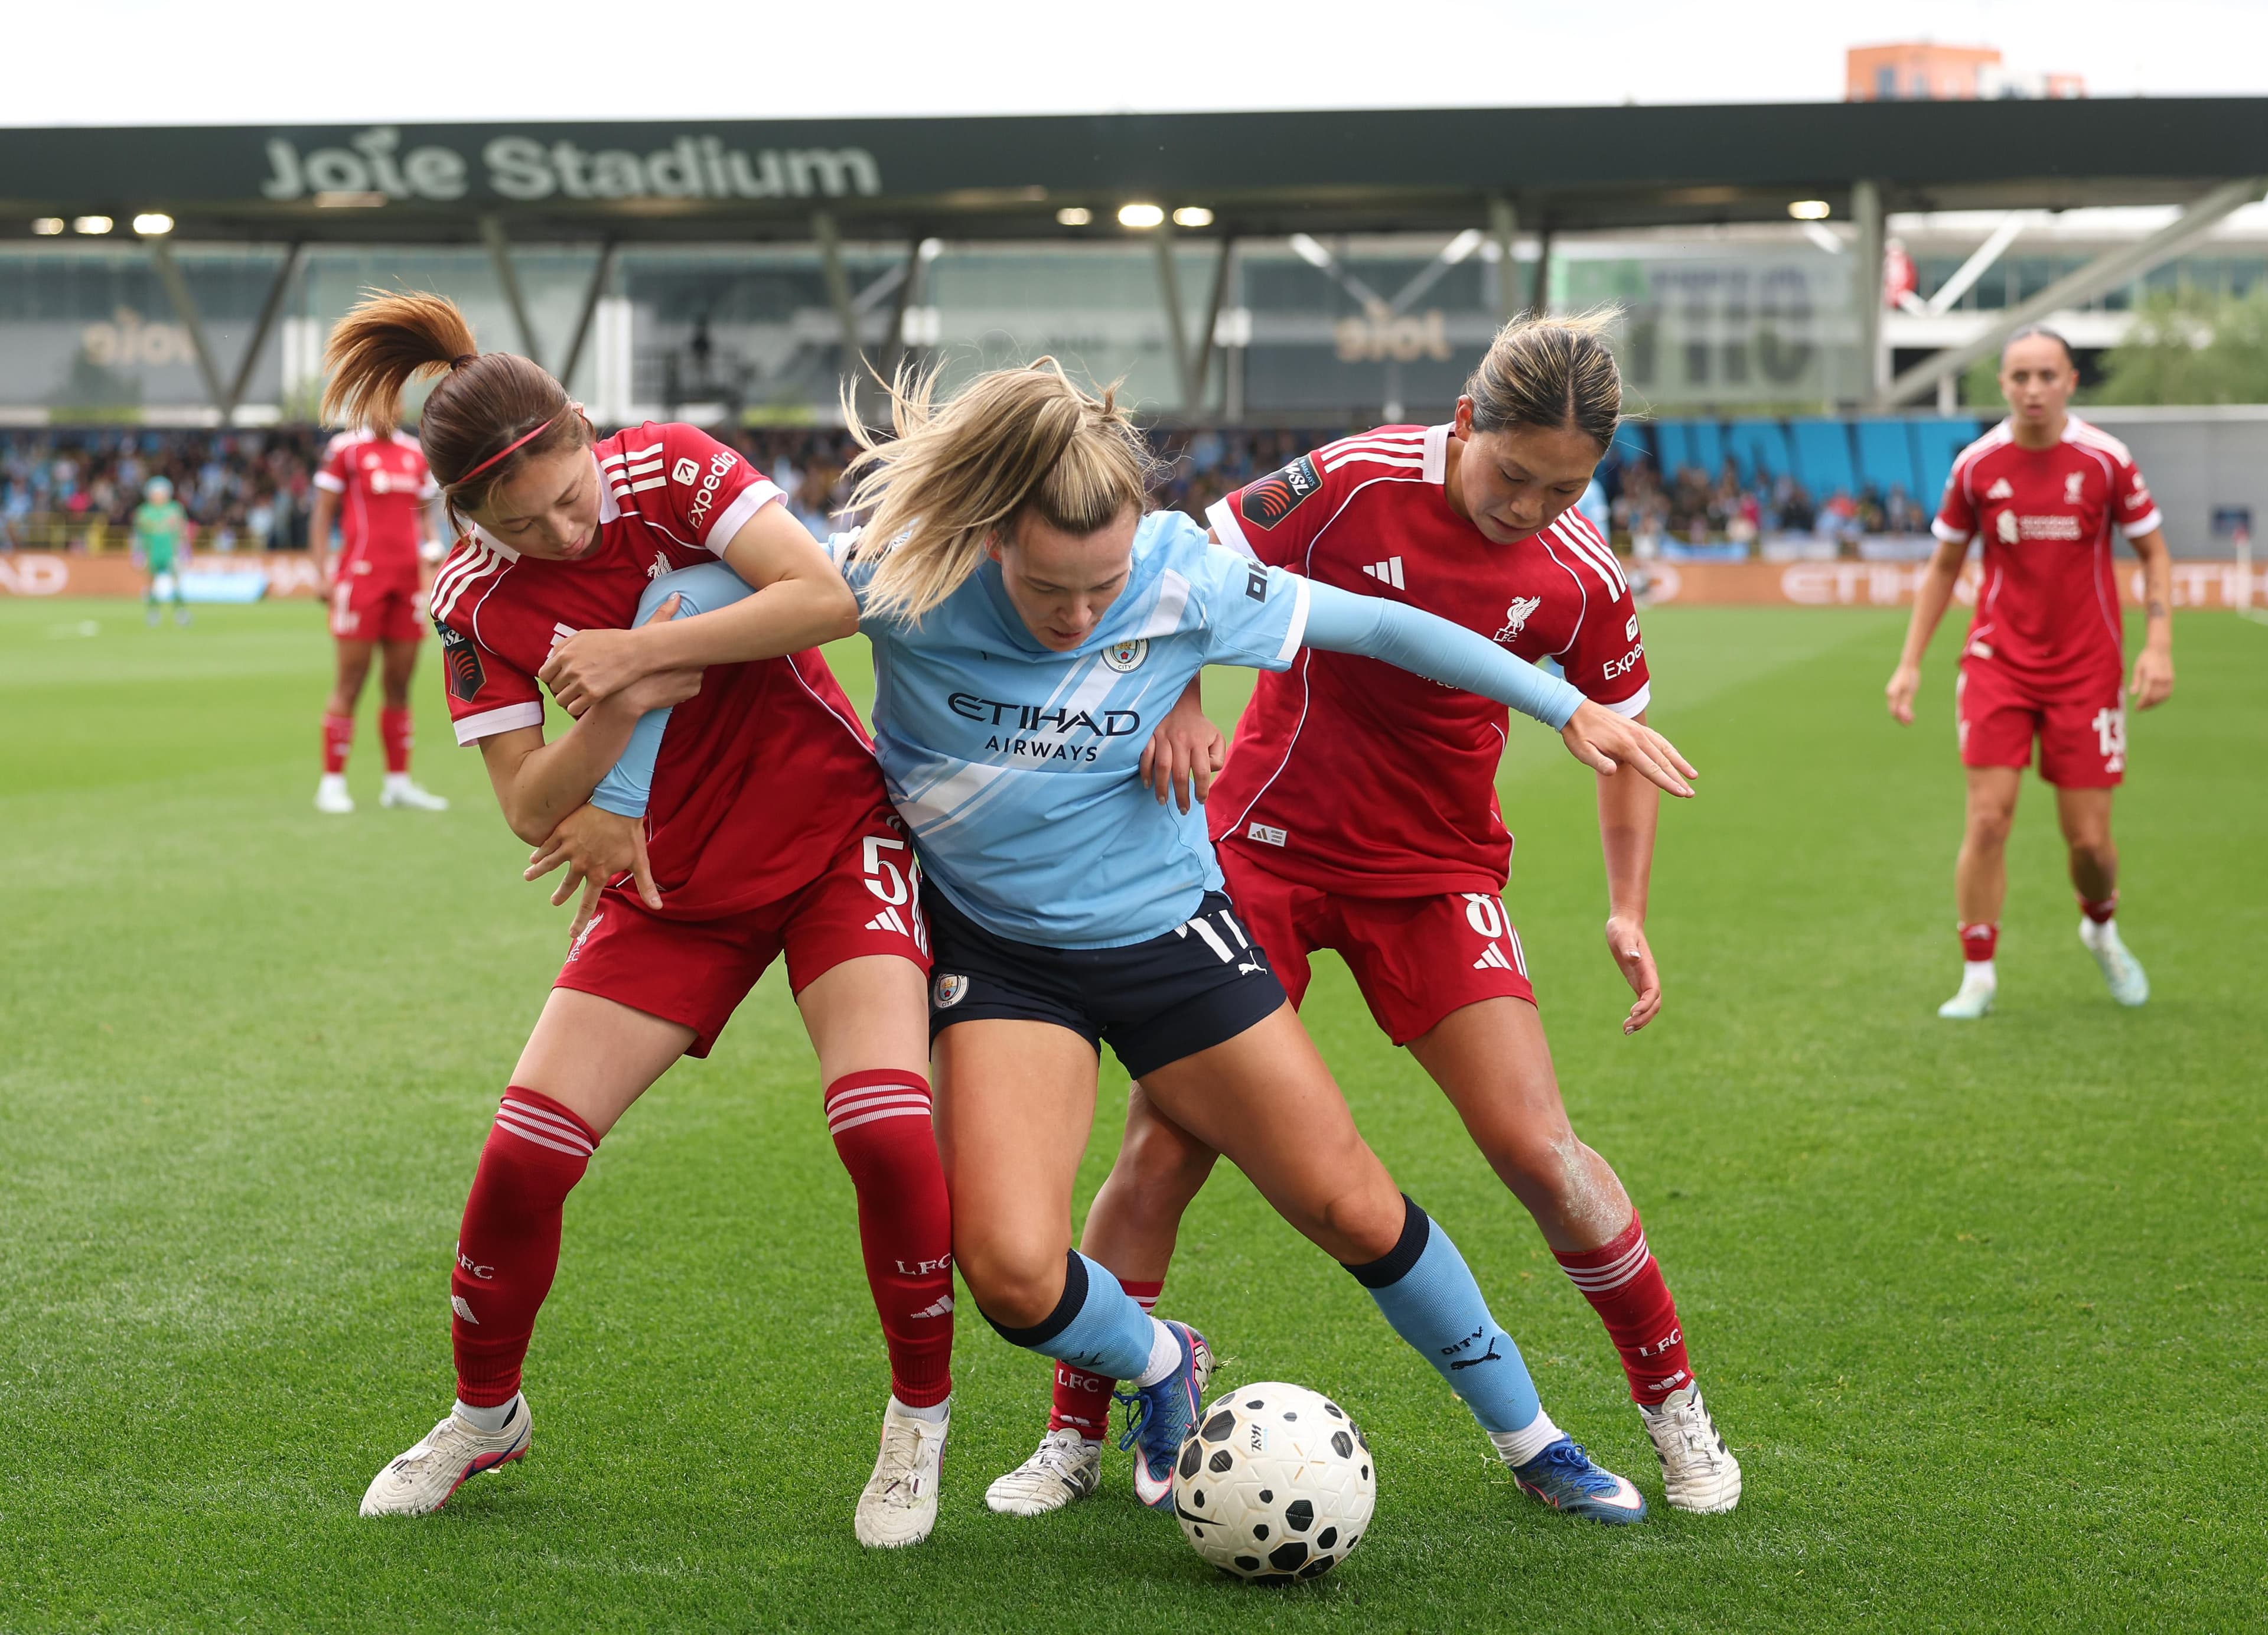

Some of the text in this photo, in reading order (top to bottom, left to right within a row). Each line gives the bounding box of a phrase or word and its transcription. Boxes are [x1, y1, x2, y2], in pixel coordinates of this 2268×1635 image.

[262, 127, 880, 201] Joie Stadium
[687, 451, 738, 529] Expedia
[1493, 631, 1517, 642] LFC
[947, 692, 1140, 737] ETIHAD
[2091, 707, 2126, 757] 13
[985, 735, 1098, 762] AIRWAYS
[862, 835, 908, 906] 5
[1461, 892, 1503, 938] 8
[895, 1253, 951, 1275] LFC
[1638, 1328, 1682, 1357] LFC
[1058, 1369, 1100, 1393] LFC
[1251, 1423, 1262, 1454] WSL
